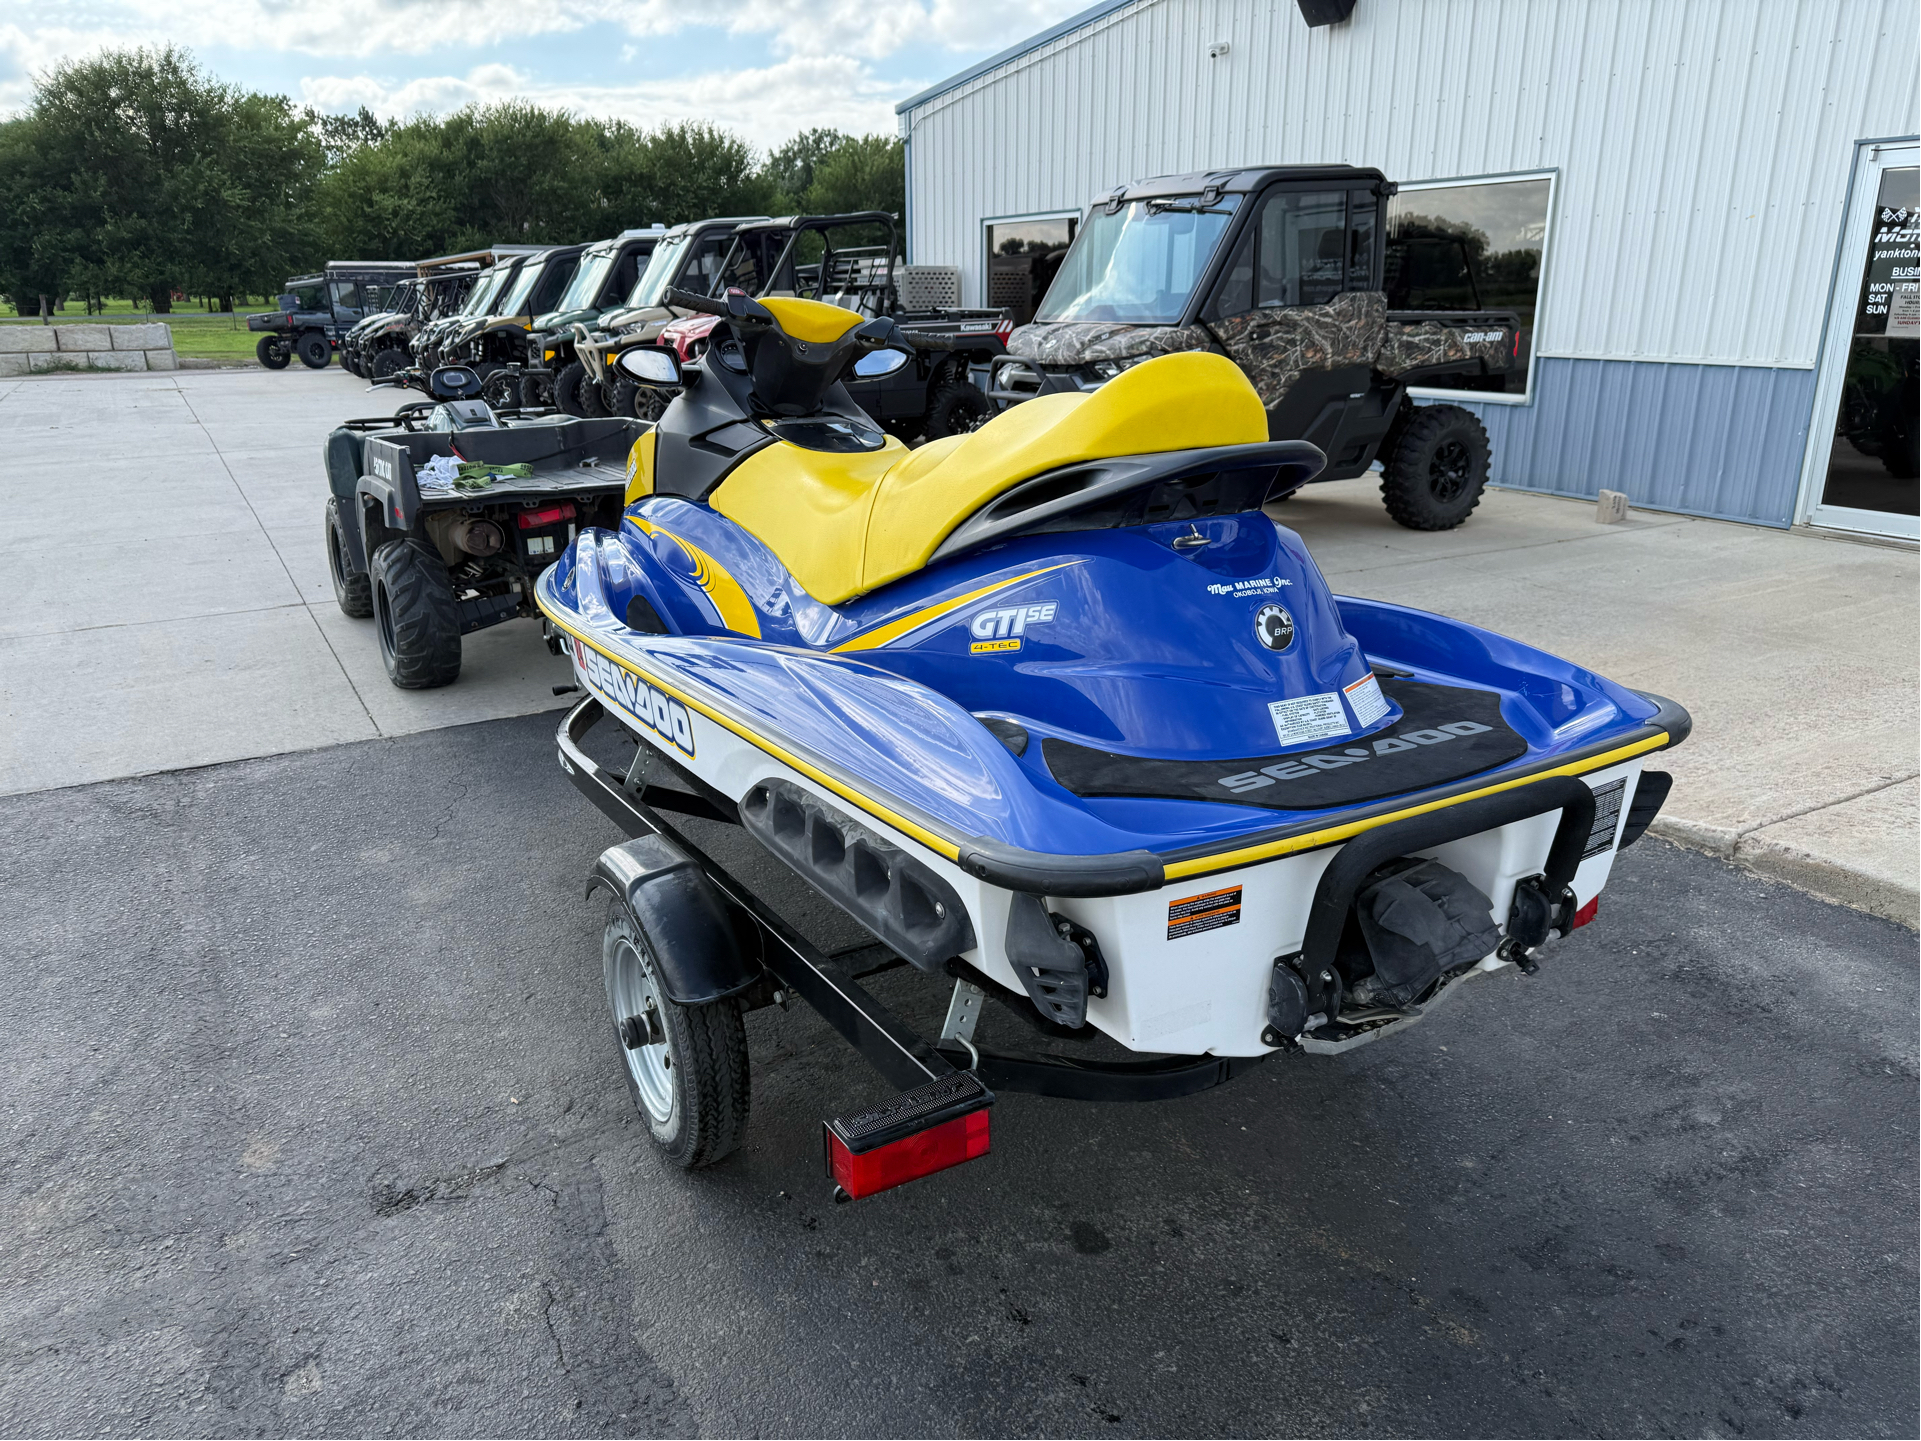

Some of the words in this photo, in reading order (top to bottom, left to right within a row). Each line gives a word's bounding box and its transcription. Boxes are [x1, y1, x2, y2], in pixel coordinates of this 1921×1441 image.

[1874, 227, 1920, 242] MOT
[1873, 248, 1920, 260] yankton
[1870, 283, 1894, 292] MON
[1901, 283, 1918, 292] FRI
[1868, 294, 1888, 303] SAT
[1866, 305, 1888, 314] SUN
[960, 323, 992, 332] Kawasaki
[1464, 331, 1503, 343] can-am
[1234, 578, 1273, 590] MARINE
[971, 608, 1028, 638] GTI
[1274, 626, 1293, 636] BRP
[974, 641, 1018, 650] 4-TEC
